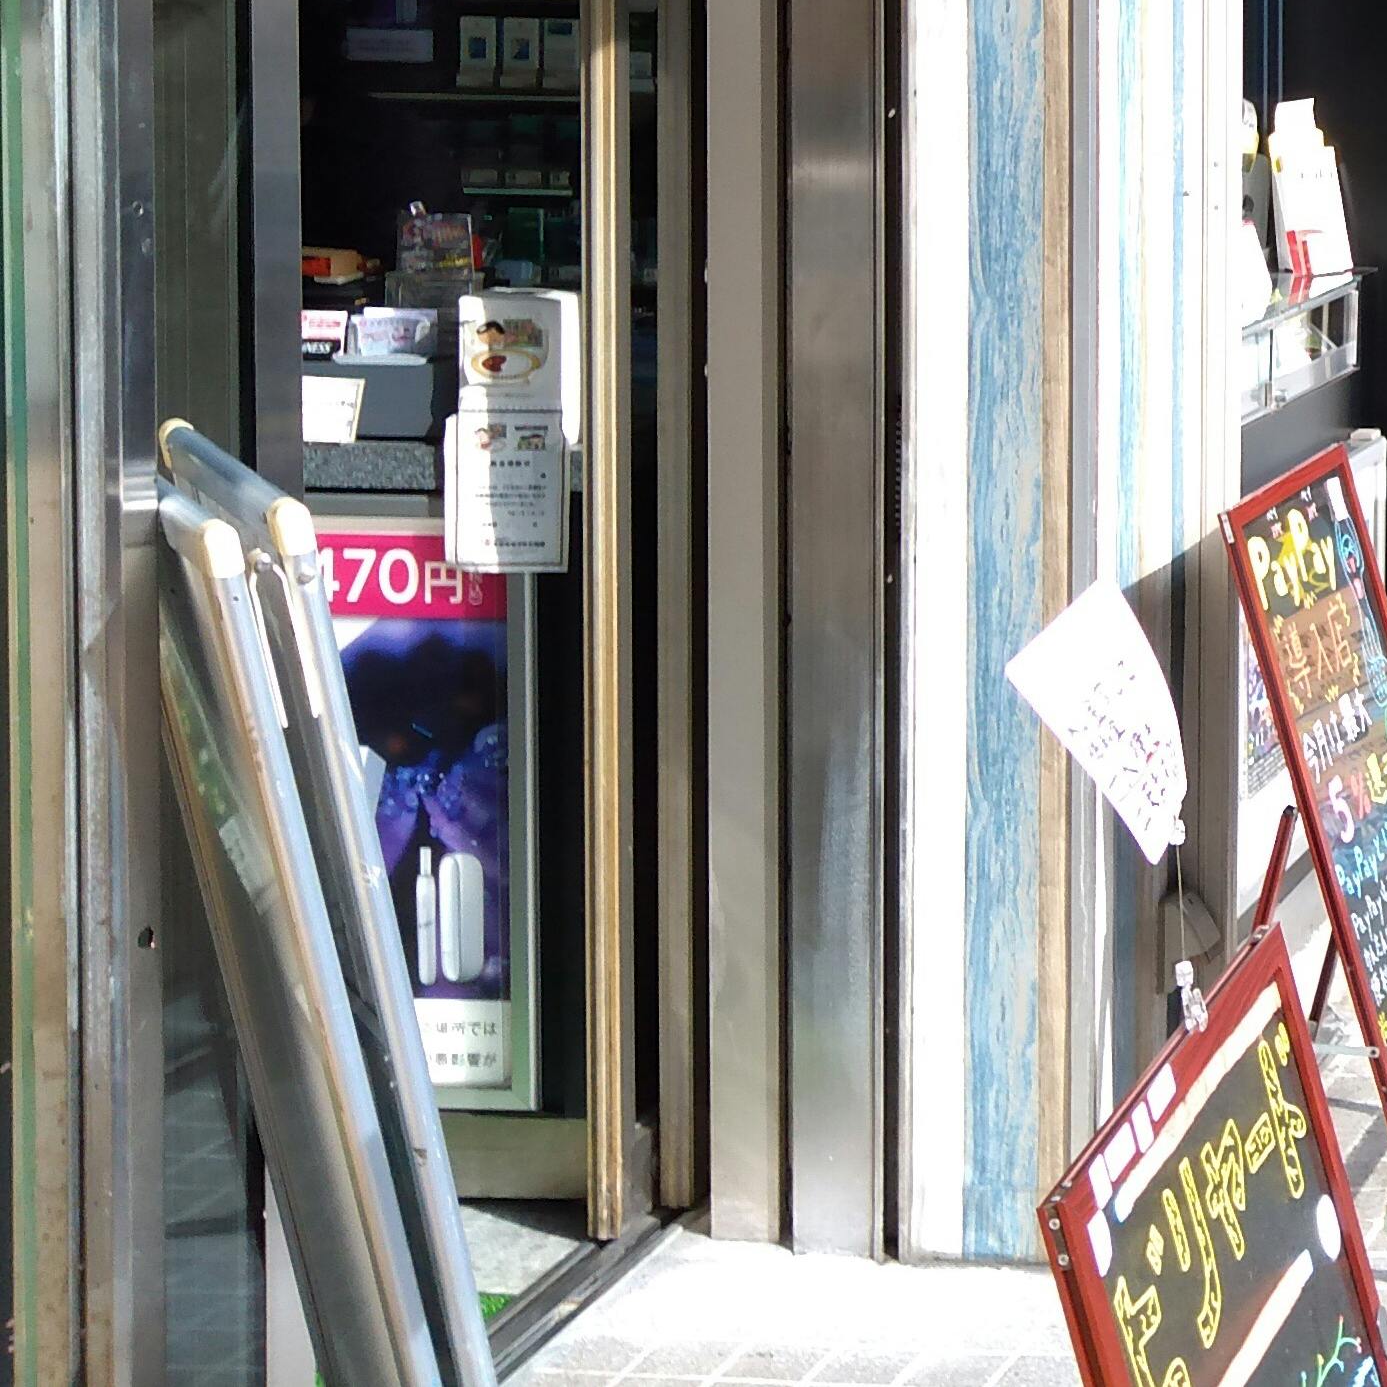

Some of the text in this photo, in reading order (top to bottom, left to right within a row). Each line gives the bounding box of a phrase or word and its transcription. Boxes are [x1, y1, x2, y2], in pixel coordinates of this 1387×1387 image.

[1247, 508, 1337, 611] PayPay
[1283, 600, 1353, 699] 導入店
